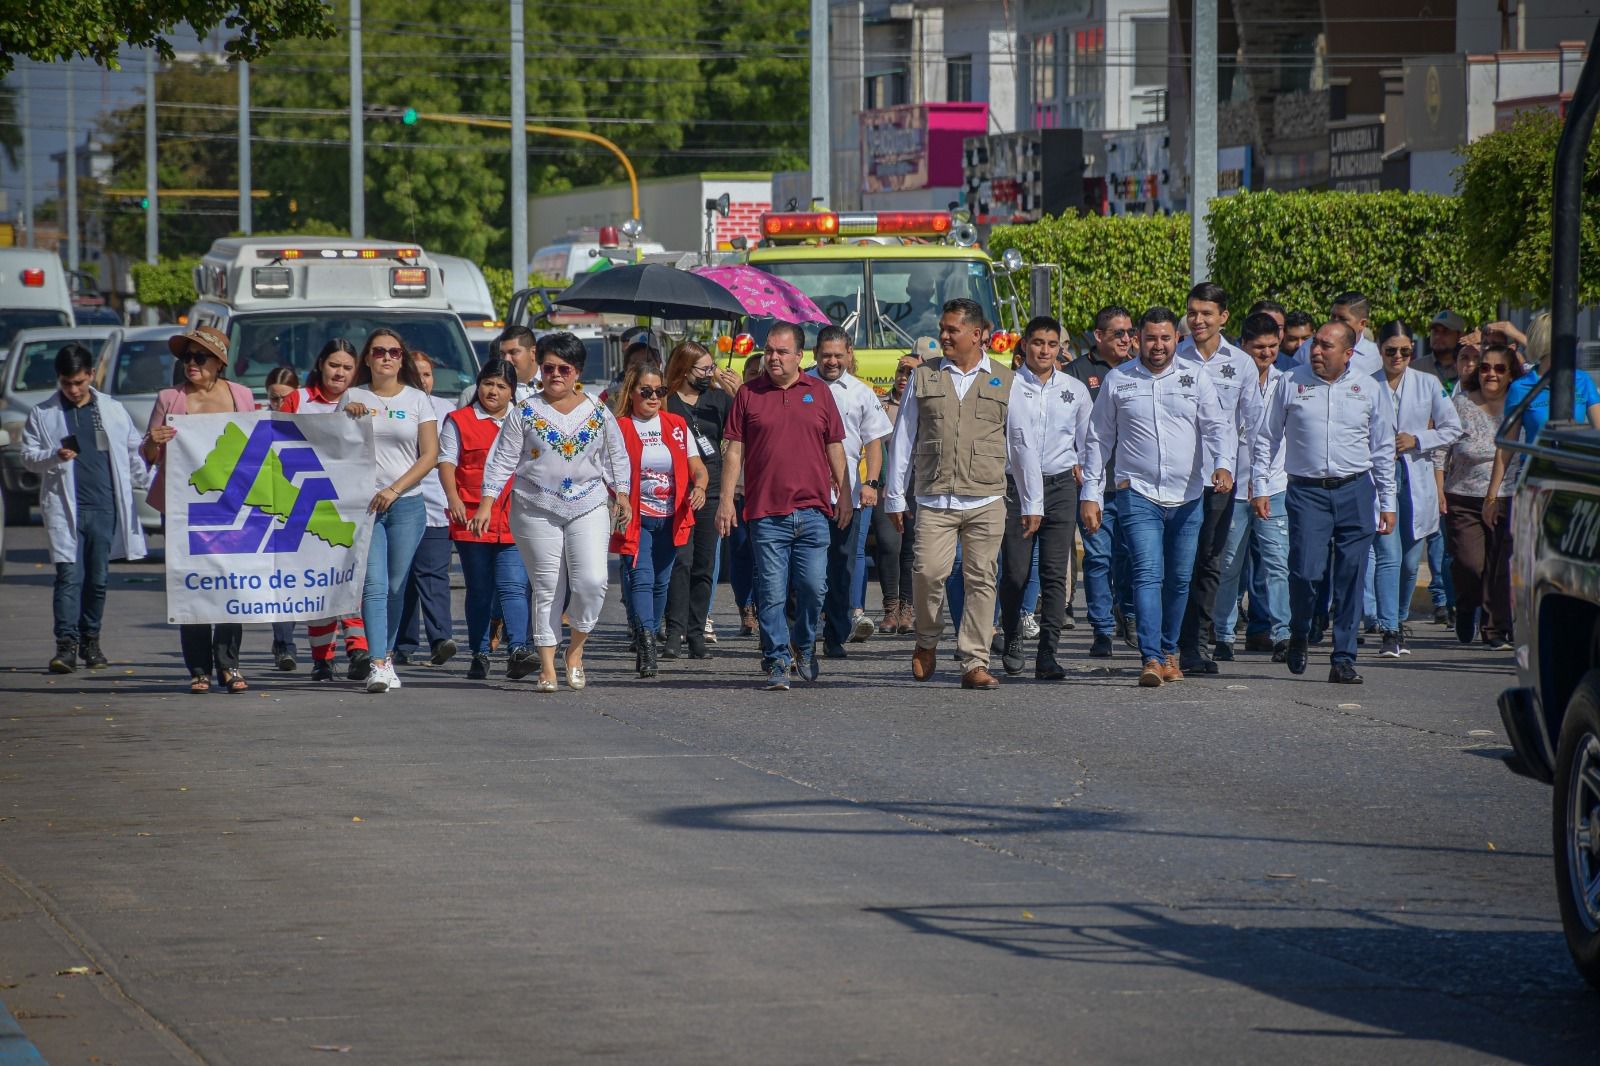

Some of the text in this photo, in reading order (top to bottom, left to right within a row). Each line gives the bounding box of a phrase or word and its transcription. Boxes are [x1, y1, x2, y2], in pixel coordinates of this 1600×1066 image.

[1561, 499, 1600, 558] 3714
[185, 563, 355, 591] Centro de Salud
[226, 595, 325, 615] Guamúchil
